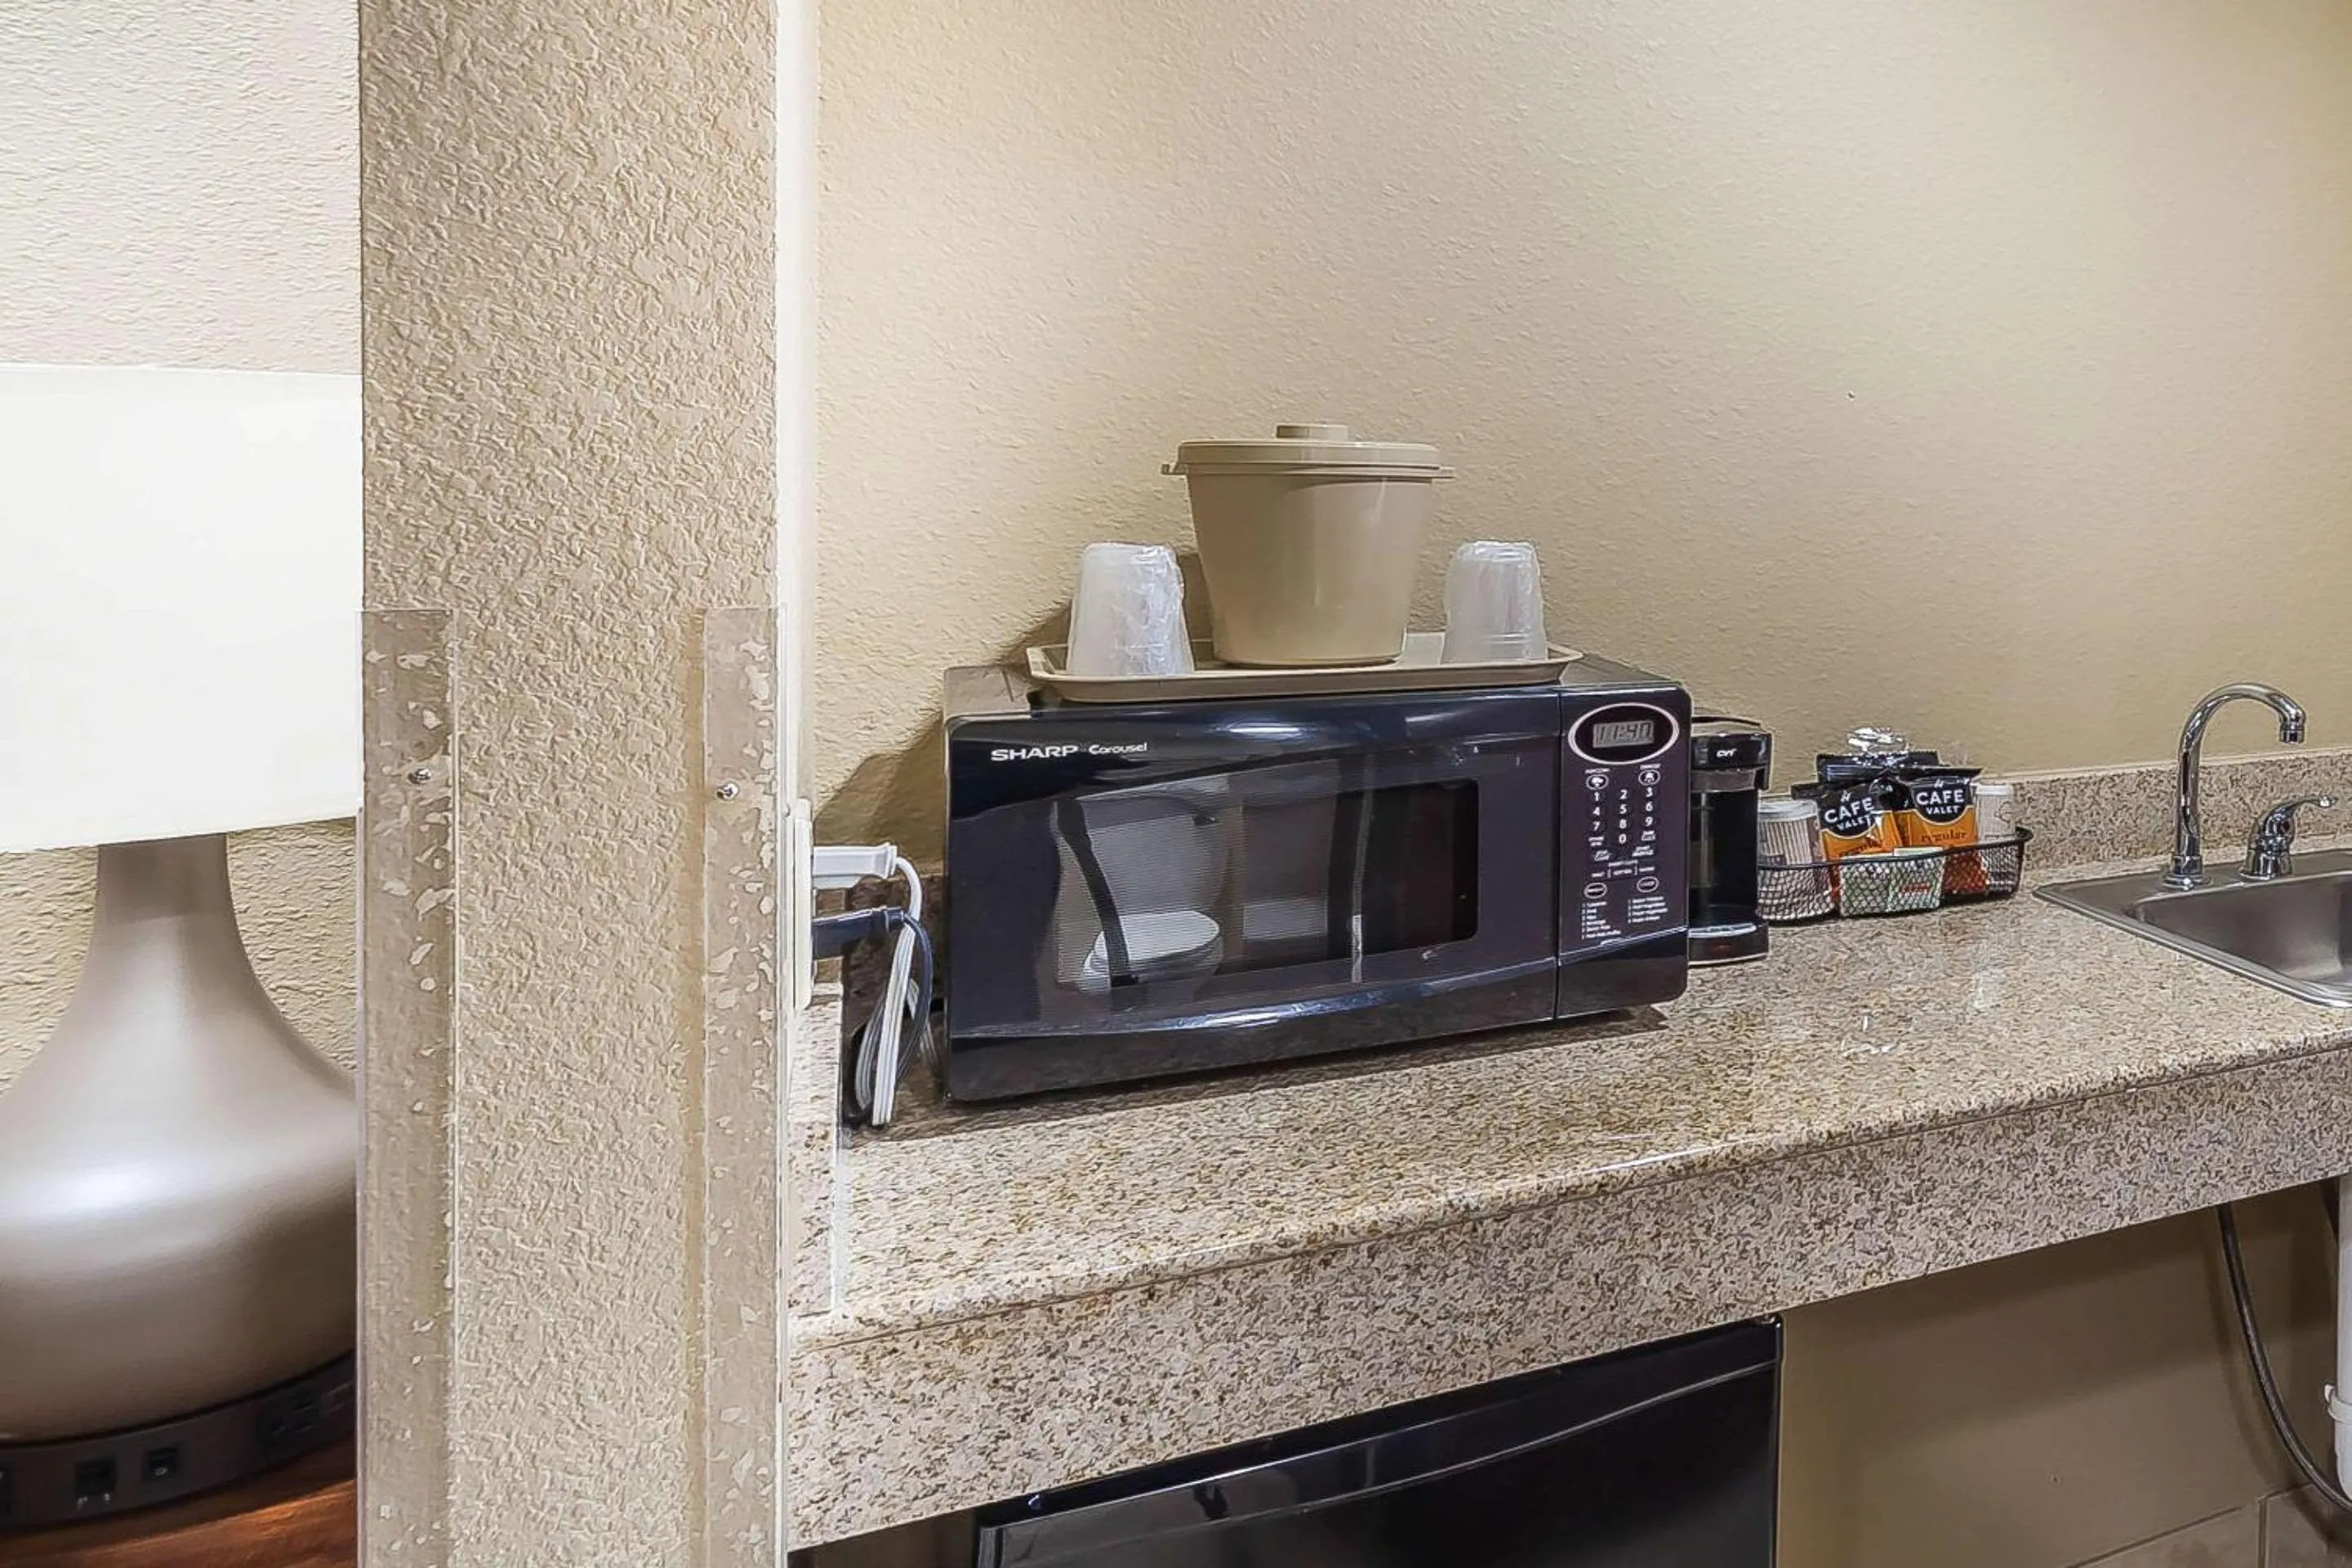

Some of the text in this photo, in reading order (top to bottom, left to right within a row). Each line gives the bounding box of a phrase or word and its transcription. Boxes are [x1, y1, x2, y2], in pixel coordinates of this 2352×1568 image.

[991, 742, 1147, 761] SHARP Carousel
[1593, 787, 1654, 802] 1 2 3
[1916, 789, 1964, 805] CAFE
[1592, 801, 1653, 816] 4 5 6
[1824, 796, 1875, 823] CAFE
[1926, 805, 1960, 815] VALET
[1592, 816, 1653, 831] 7 8 9
[1836, 813, 1872, 831] VALET
[1619, 833, 1627, 844] 0
